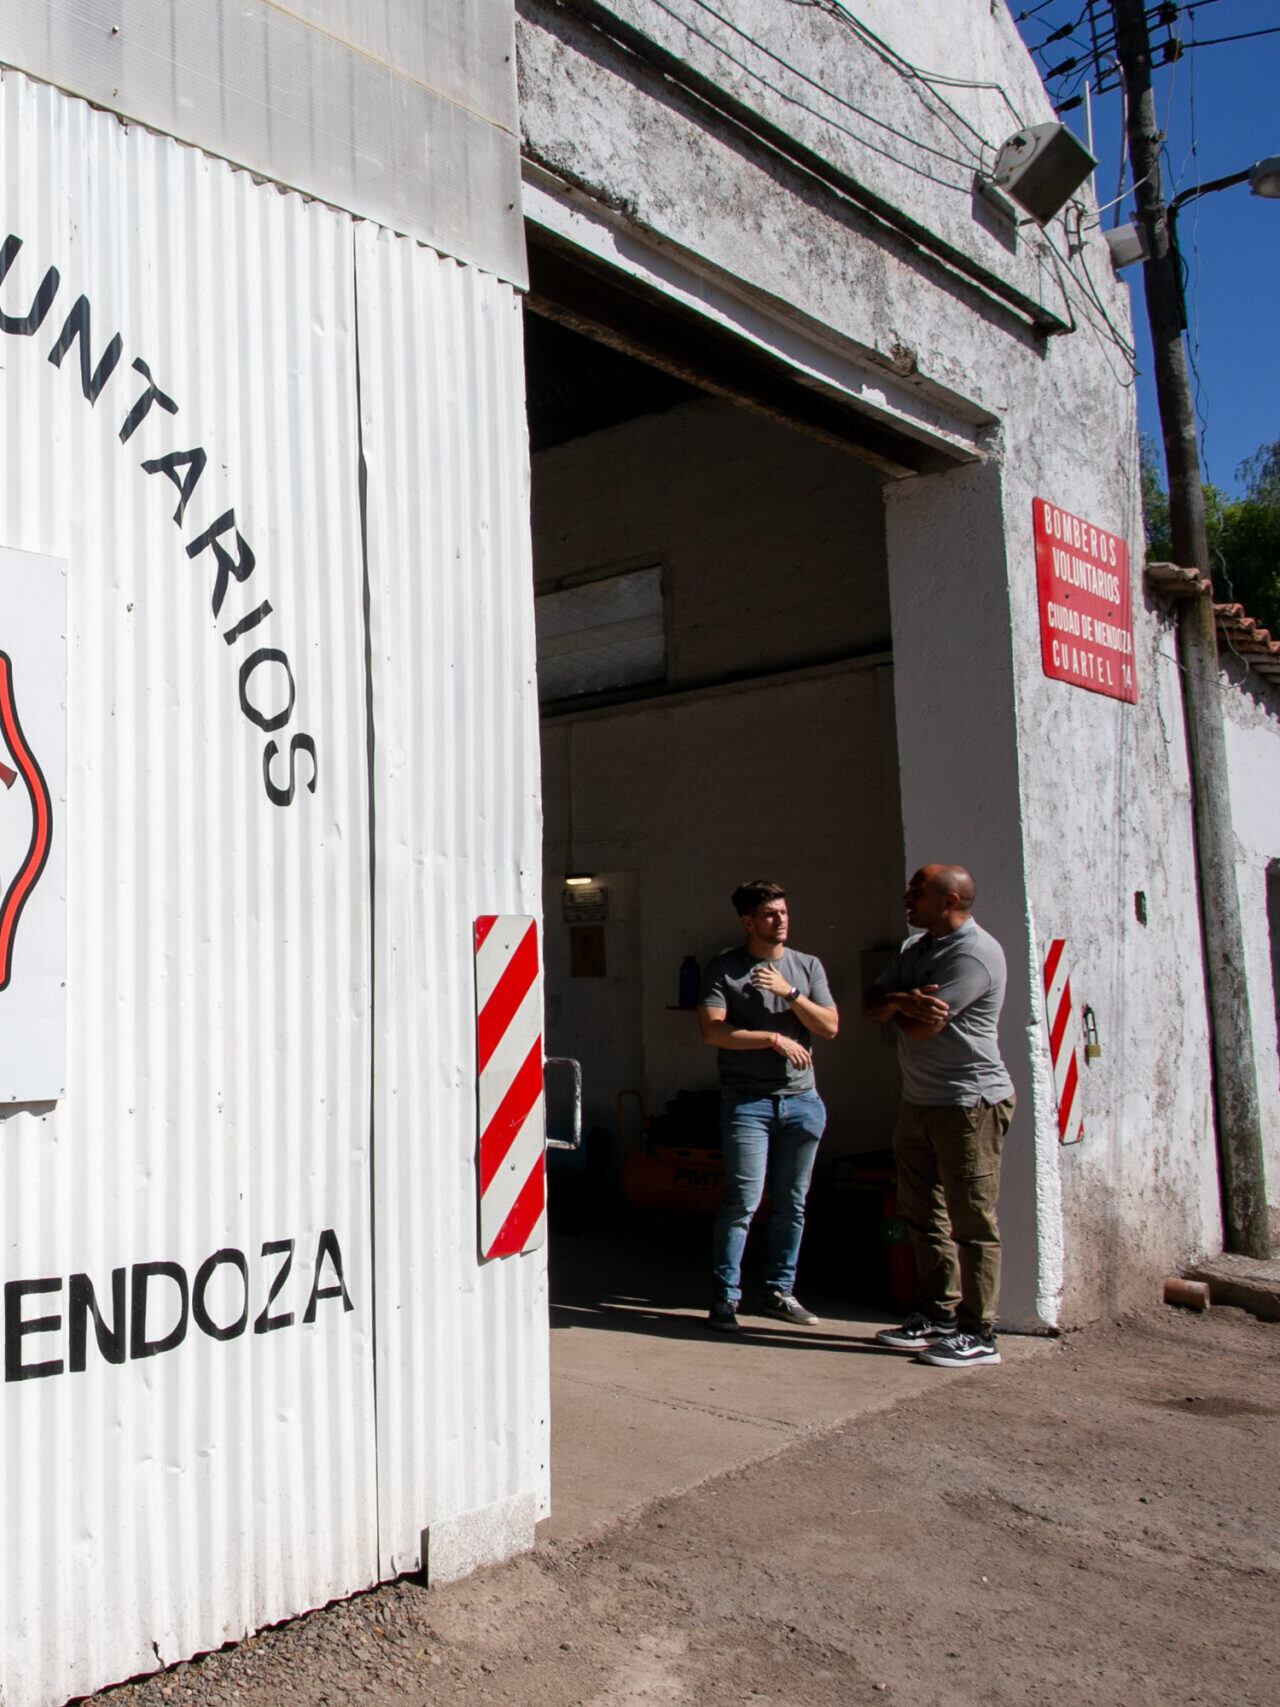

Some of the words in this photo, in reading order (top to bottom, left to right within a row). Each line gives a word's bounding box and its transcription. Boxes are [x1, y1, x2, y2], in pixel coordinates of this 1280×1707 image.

[1043, 503, 1117, 567] BOMBEROS
[1052, 546, 1121, 606] VOLUNTARIOS
[1047, 600, 1081, 637] CIUDAD
[1081, 613, 1094, 642] DE
[1094, 618, 1133, 656] MENDOZA
[1052, 640, 1113, 686] CUARTEL
[1122, 665, 1132, 688] 14
